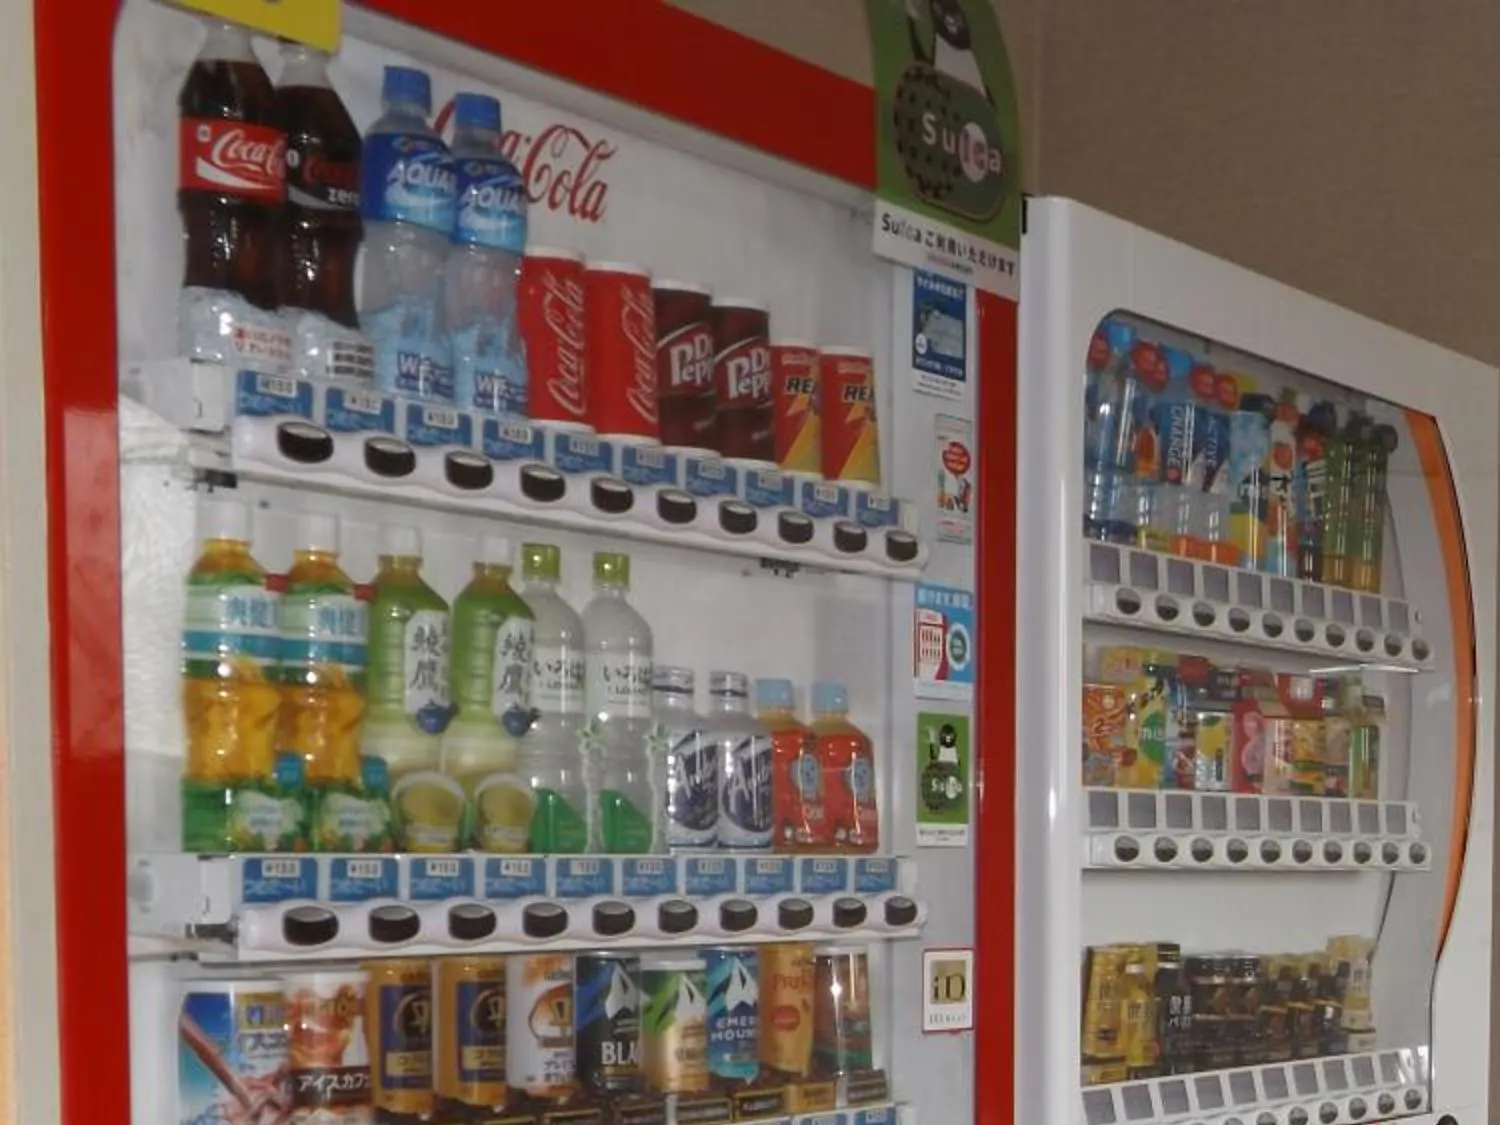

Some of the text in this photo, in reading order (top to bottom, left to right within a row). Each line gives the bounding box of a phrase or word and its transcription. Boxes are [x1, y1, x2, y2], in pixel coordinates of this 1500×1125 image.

[922, 112, 1002, 174] Suica
[386, 160, 458, 193] AQUA
[716, 1016, 758, 1030] EMER
[711, 1029, 758, 1042] MOUN
